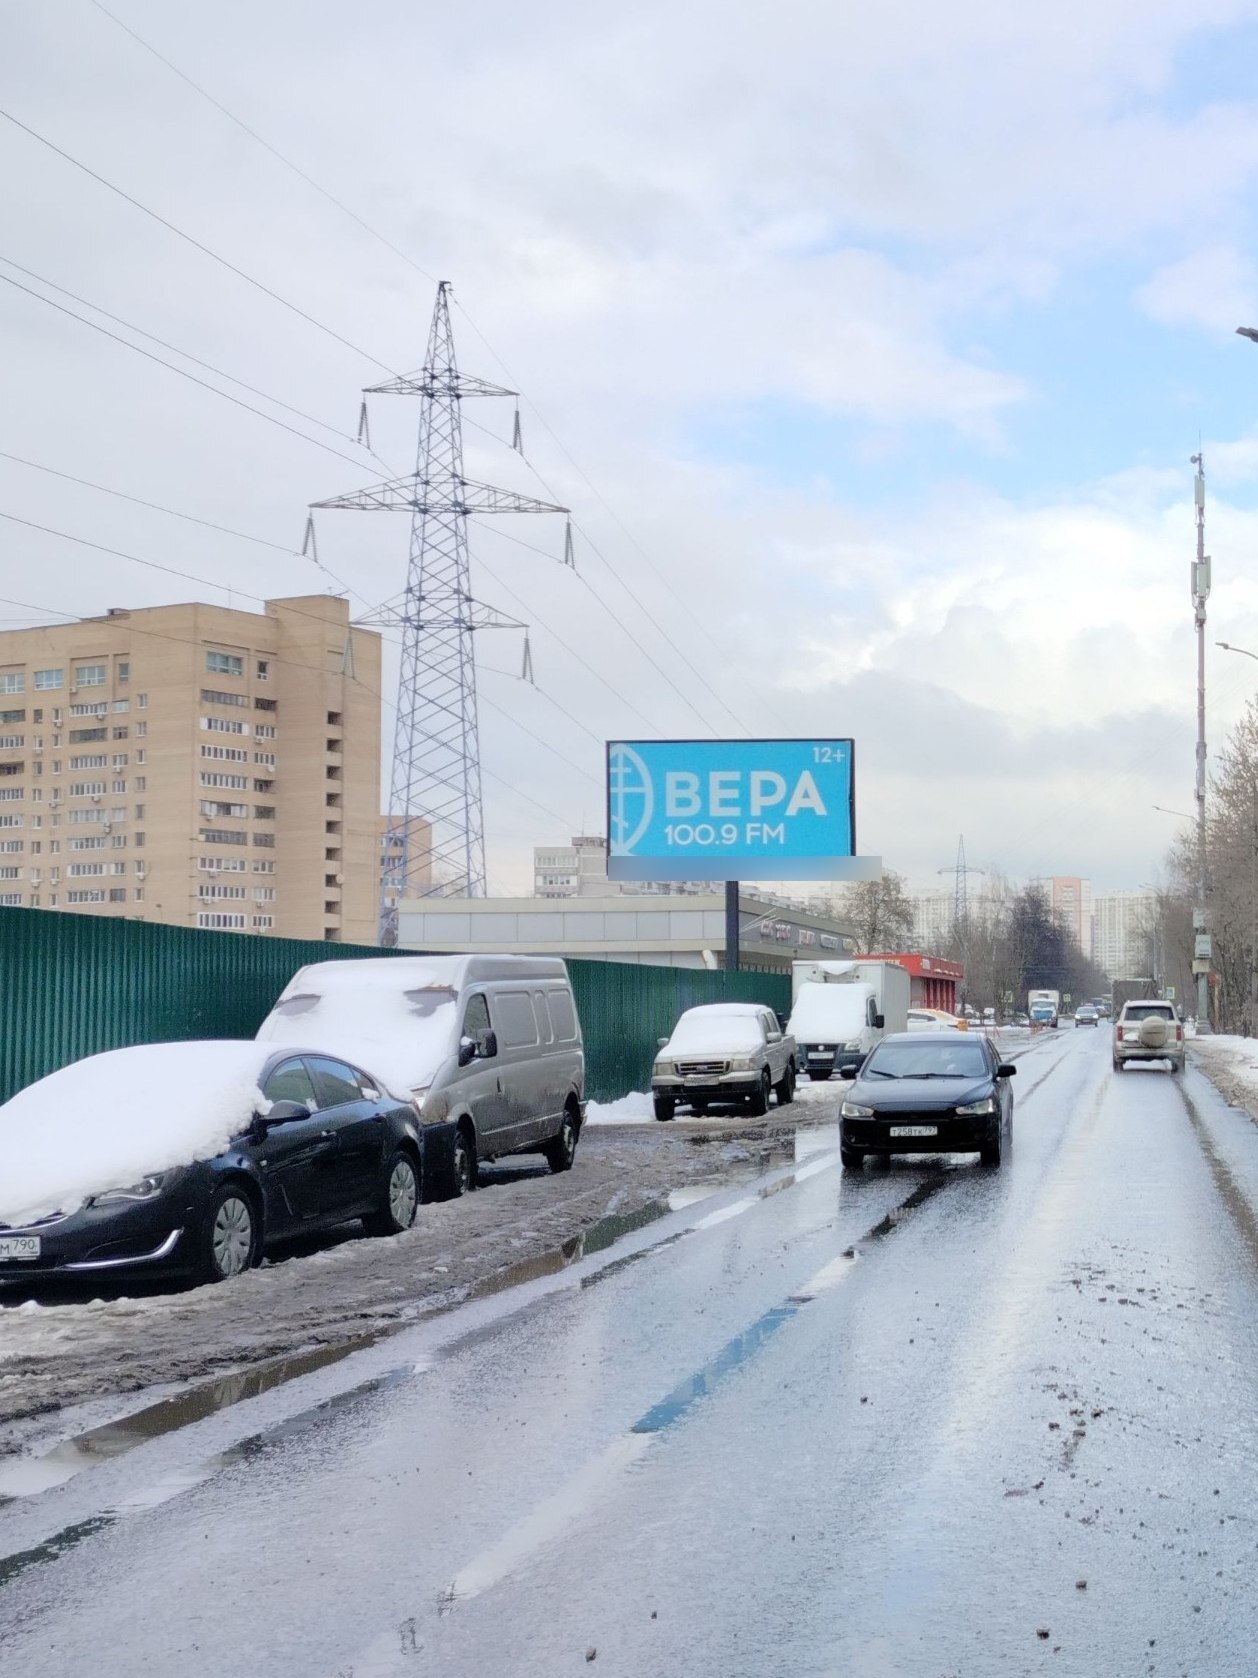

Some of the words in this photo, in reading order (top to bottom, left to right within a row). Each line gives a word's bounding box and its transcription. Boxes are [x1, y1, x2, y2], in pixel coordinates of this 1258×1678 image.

[813, 747, 845, 763] 12+
[665, 770, 828, 818] ВЕРА
[665, 824, 737, 845] 100.9
[746, 823, 785, 844] FM
[12, 1239, 36, 1251] 790
